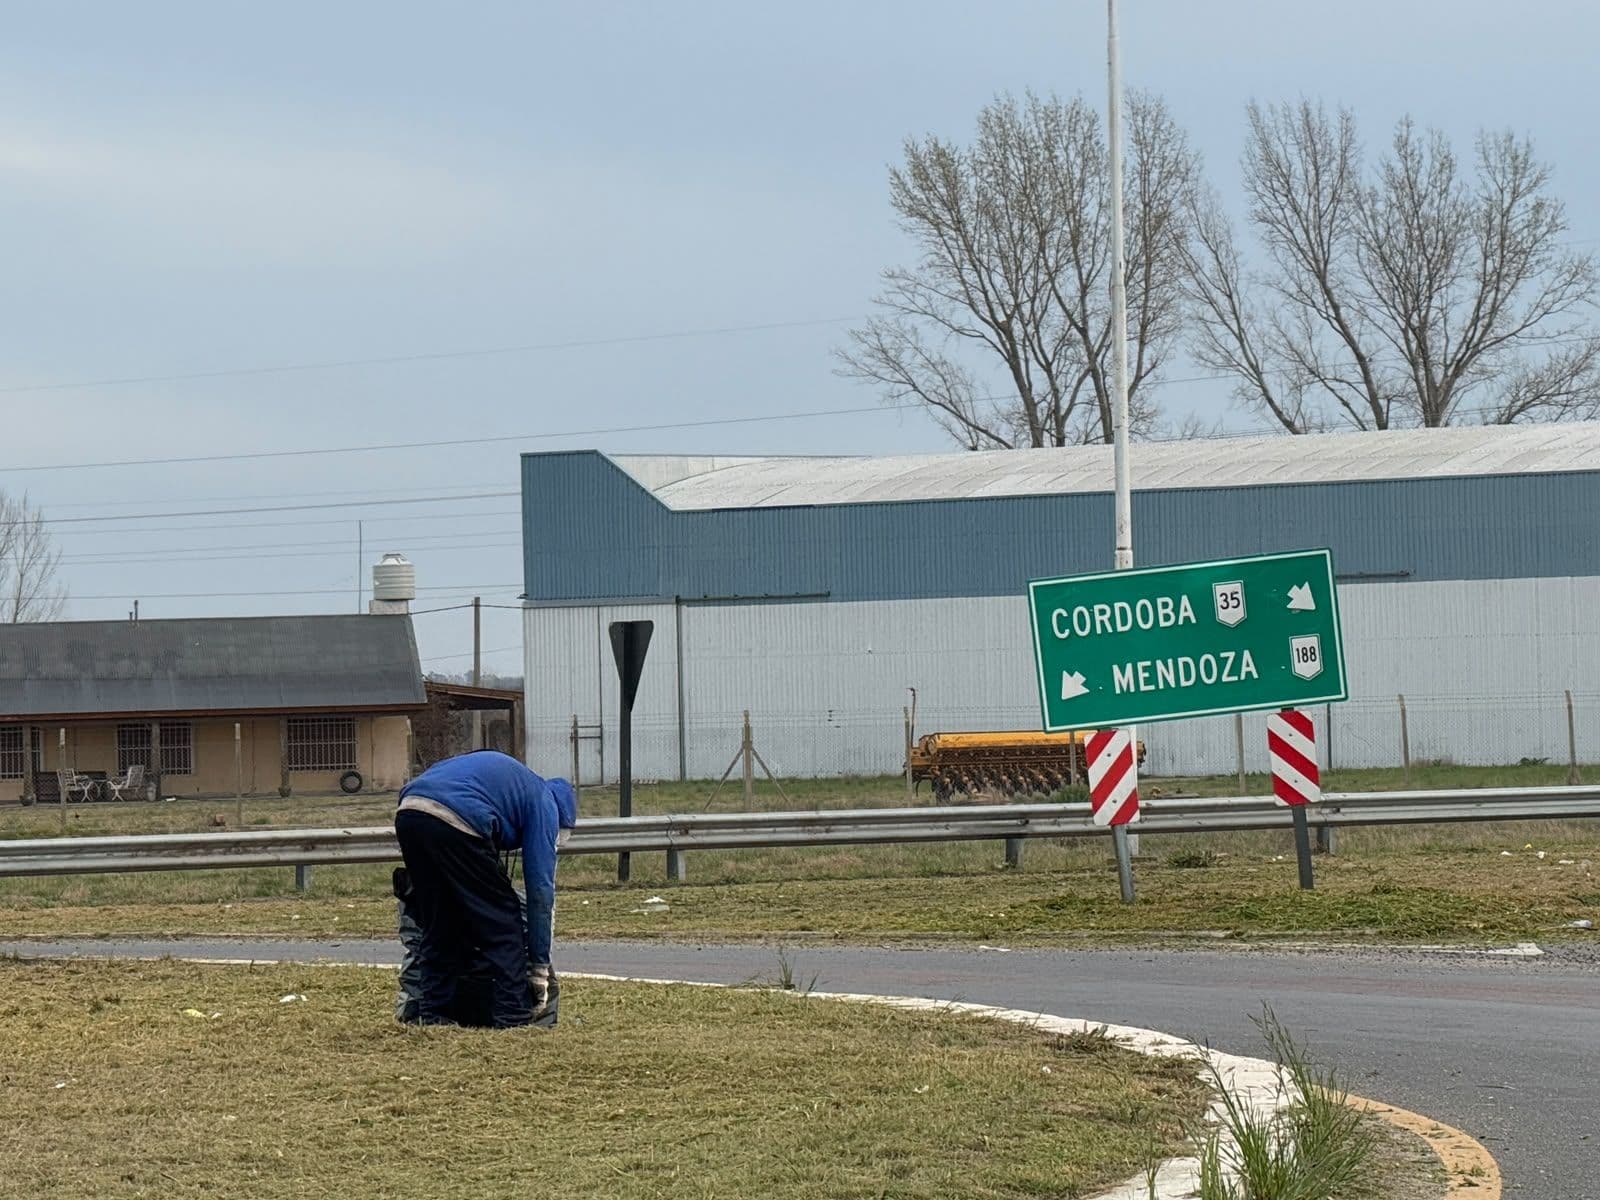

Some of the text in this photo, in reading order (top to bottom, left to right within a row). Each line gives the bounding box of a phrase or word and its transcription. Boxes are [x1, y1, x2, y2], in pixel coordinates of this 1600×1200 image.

[1051, 594, 1197, 639] CORDOBA
[1219, 590, 1241, 611] 35
[1295, 646, 1317, 664] 188
[1111, 649, 1260, 695] MENDOZA
